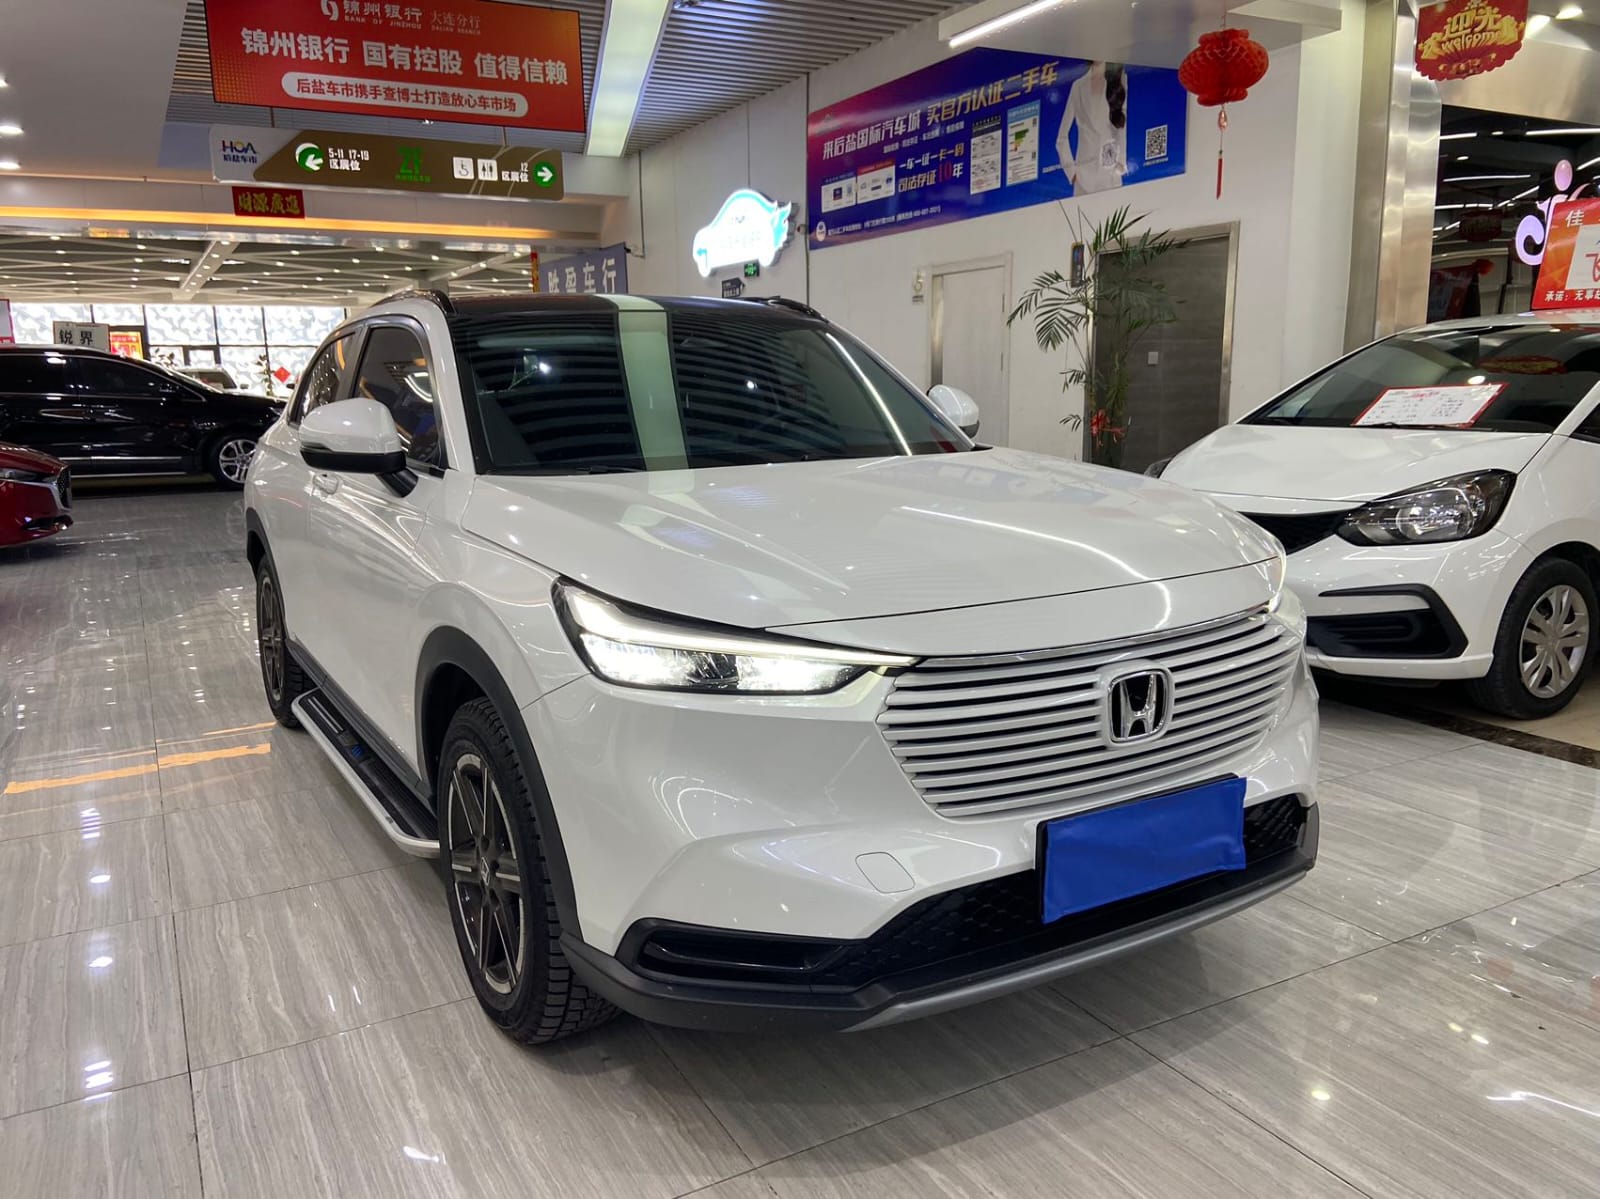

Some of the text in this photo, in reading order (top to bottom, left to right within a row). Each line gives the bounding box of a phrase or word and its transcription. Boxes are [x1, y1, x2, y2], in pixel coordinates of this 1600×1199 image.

[343, 0, 422, 22] 锦州银行
[344, 15, 366, 24] BANK
[372, 18, 383, 26] OF
[431, 10, 482, 28] 大连分行
[240, 27, 568, 86] 锦州银行 国有控股 值得信赖
[296, 77, 517, 113] 后盐车市携手查博士打造放心车市场
[823, 111, 921, 160] 来后盐国际汽车城
[927, 60, 1059, 126] 买官方认证二手车
[58, 329, 94, 346] 锐界
